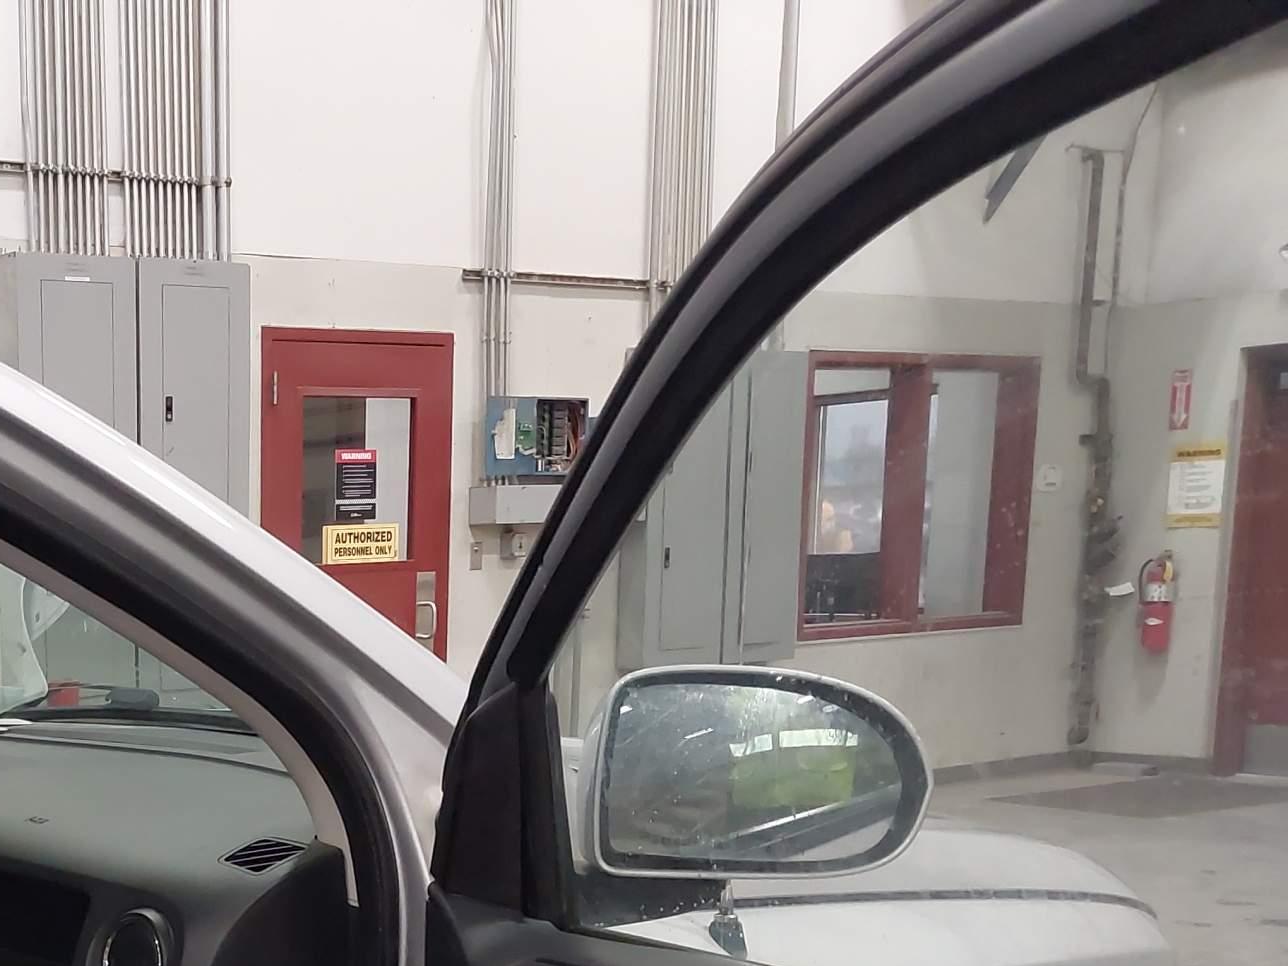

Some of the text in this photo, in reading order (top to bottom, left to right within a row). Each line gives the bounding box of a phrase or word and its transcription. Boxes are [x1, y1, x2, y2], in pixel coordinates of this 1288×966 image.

[341, 452, 372, 460] WARNING
[335, 530, 393, 545] AUTHORIZED
[334, 544, 392, 558] PERSONNEL ONLY
